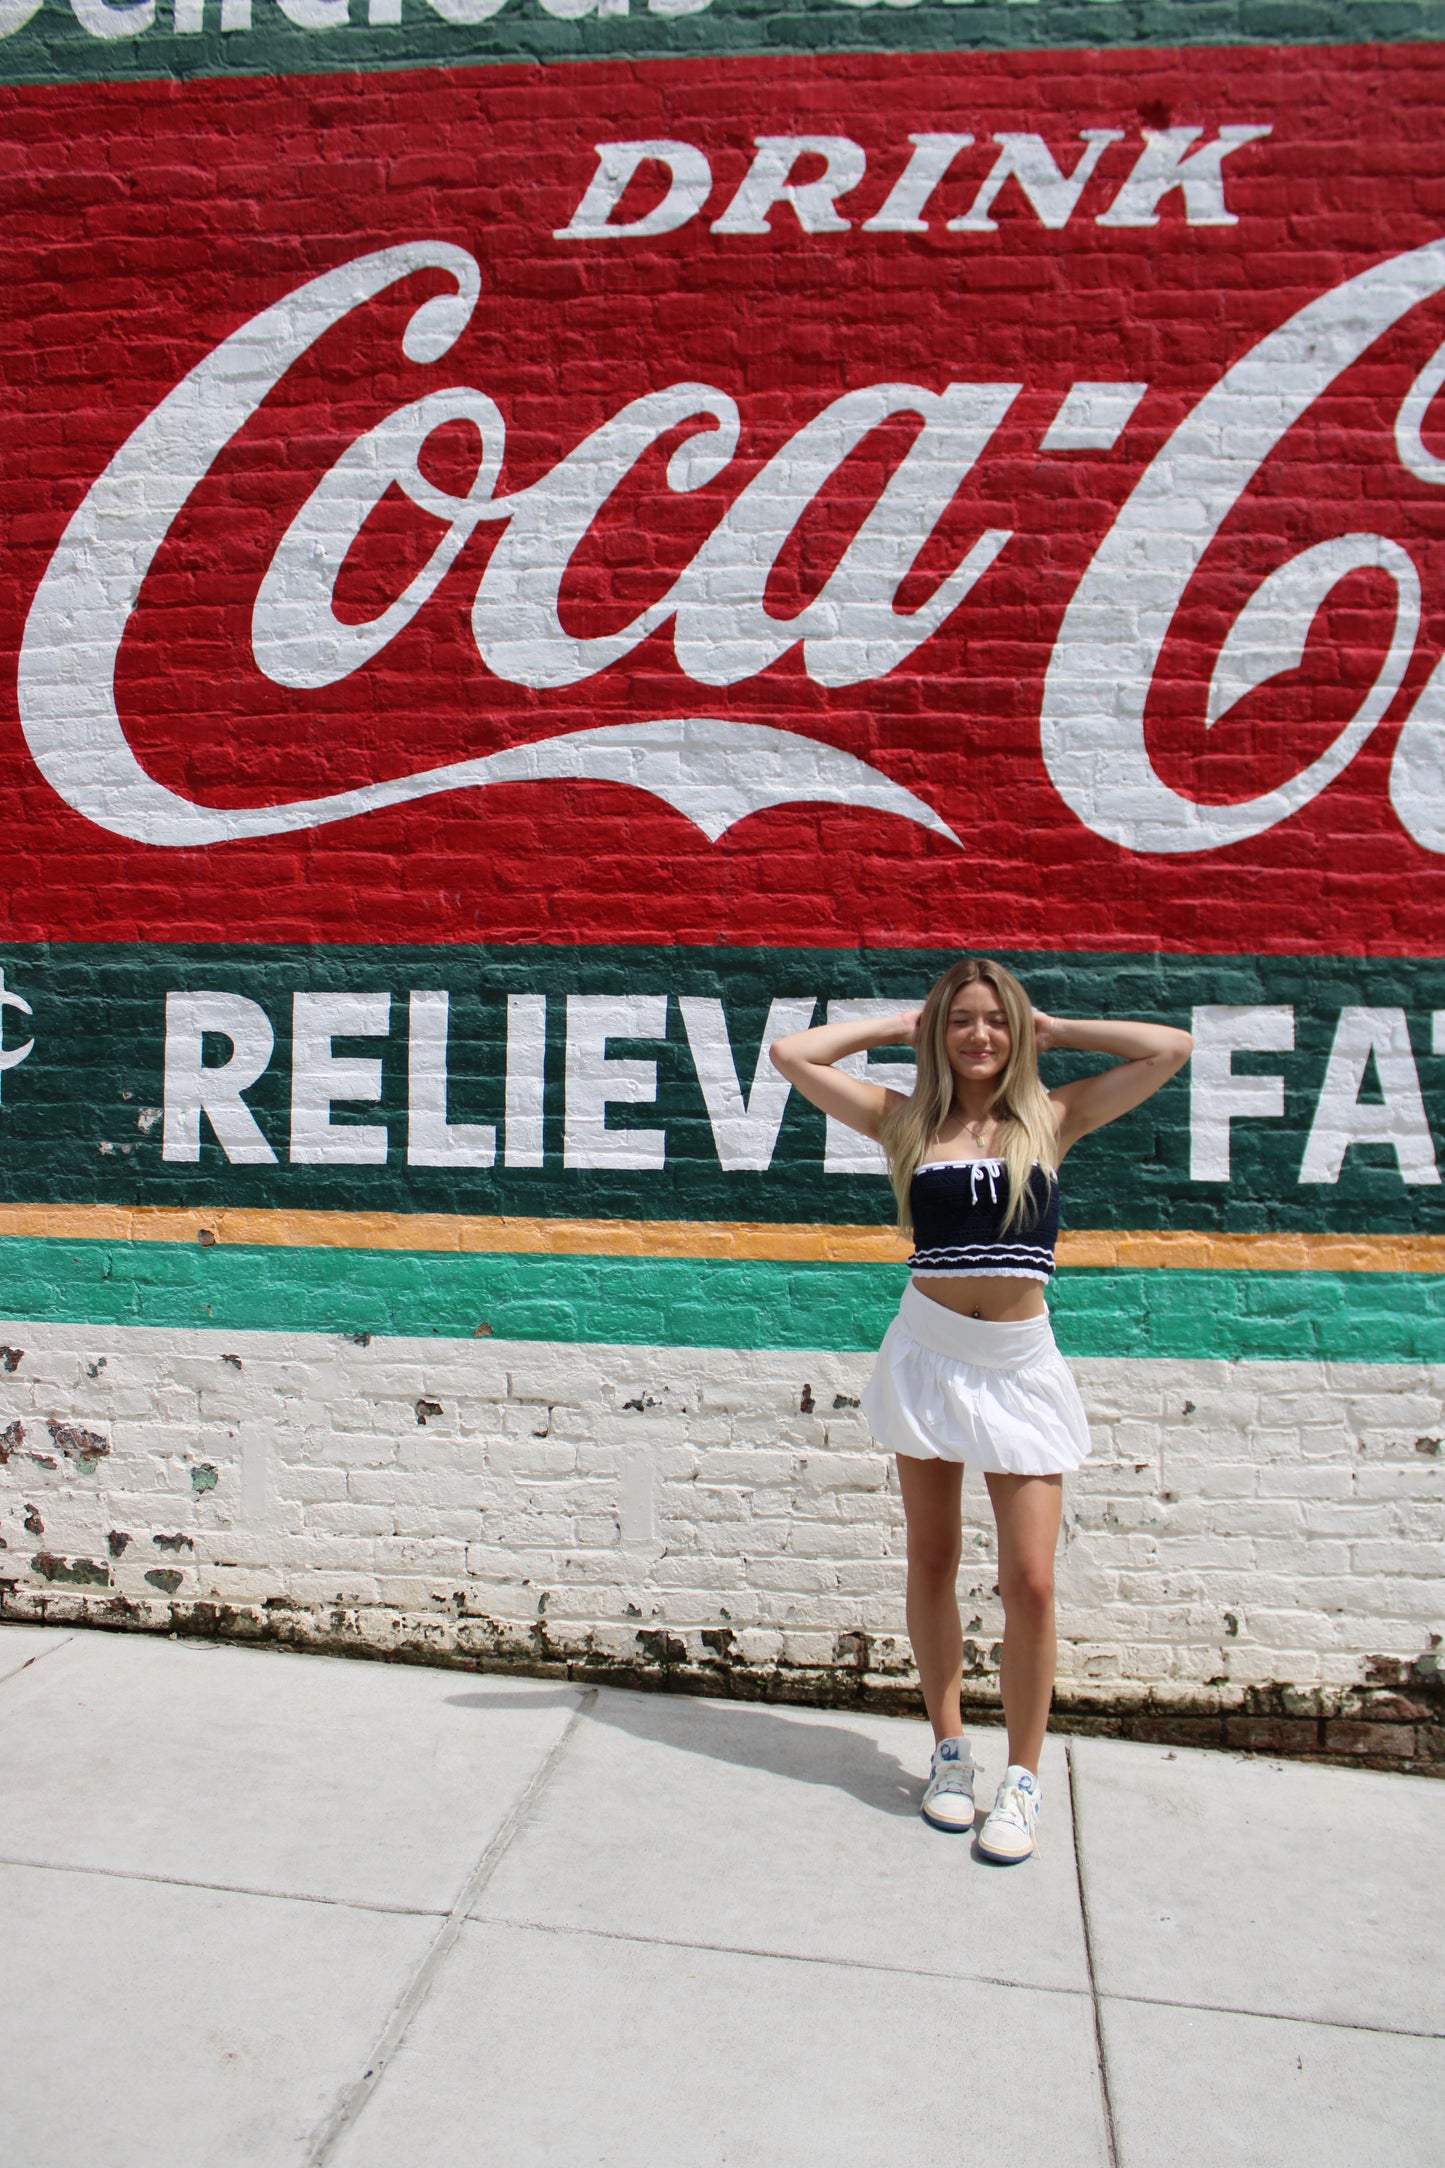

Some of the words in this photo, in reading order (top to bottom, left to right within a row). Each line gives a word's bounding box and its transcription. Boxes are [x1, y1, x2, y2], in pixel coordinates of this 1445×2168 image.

[553, 124, 1273, 239] DRINK
[17, 239, 1445, 854] Coca-C
[162, 990, 1046, 1174] RELIEVE
[1190, 1004, 1445, 1186] FA
